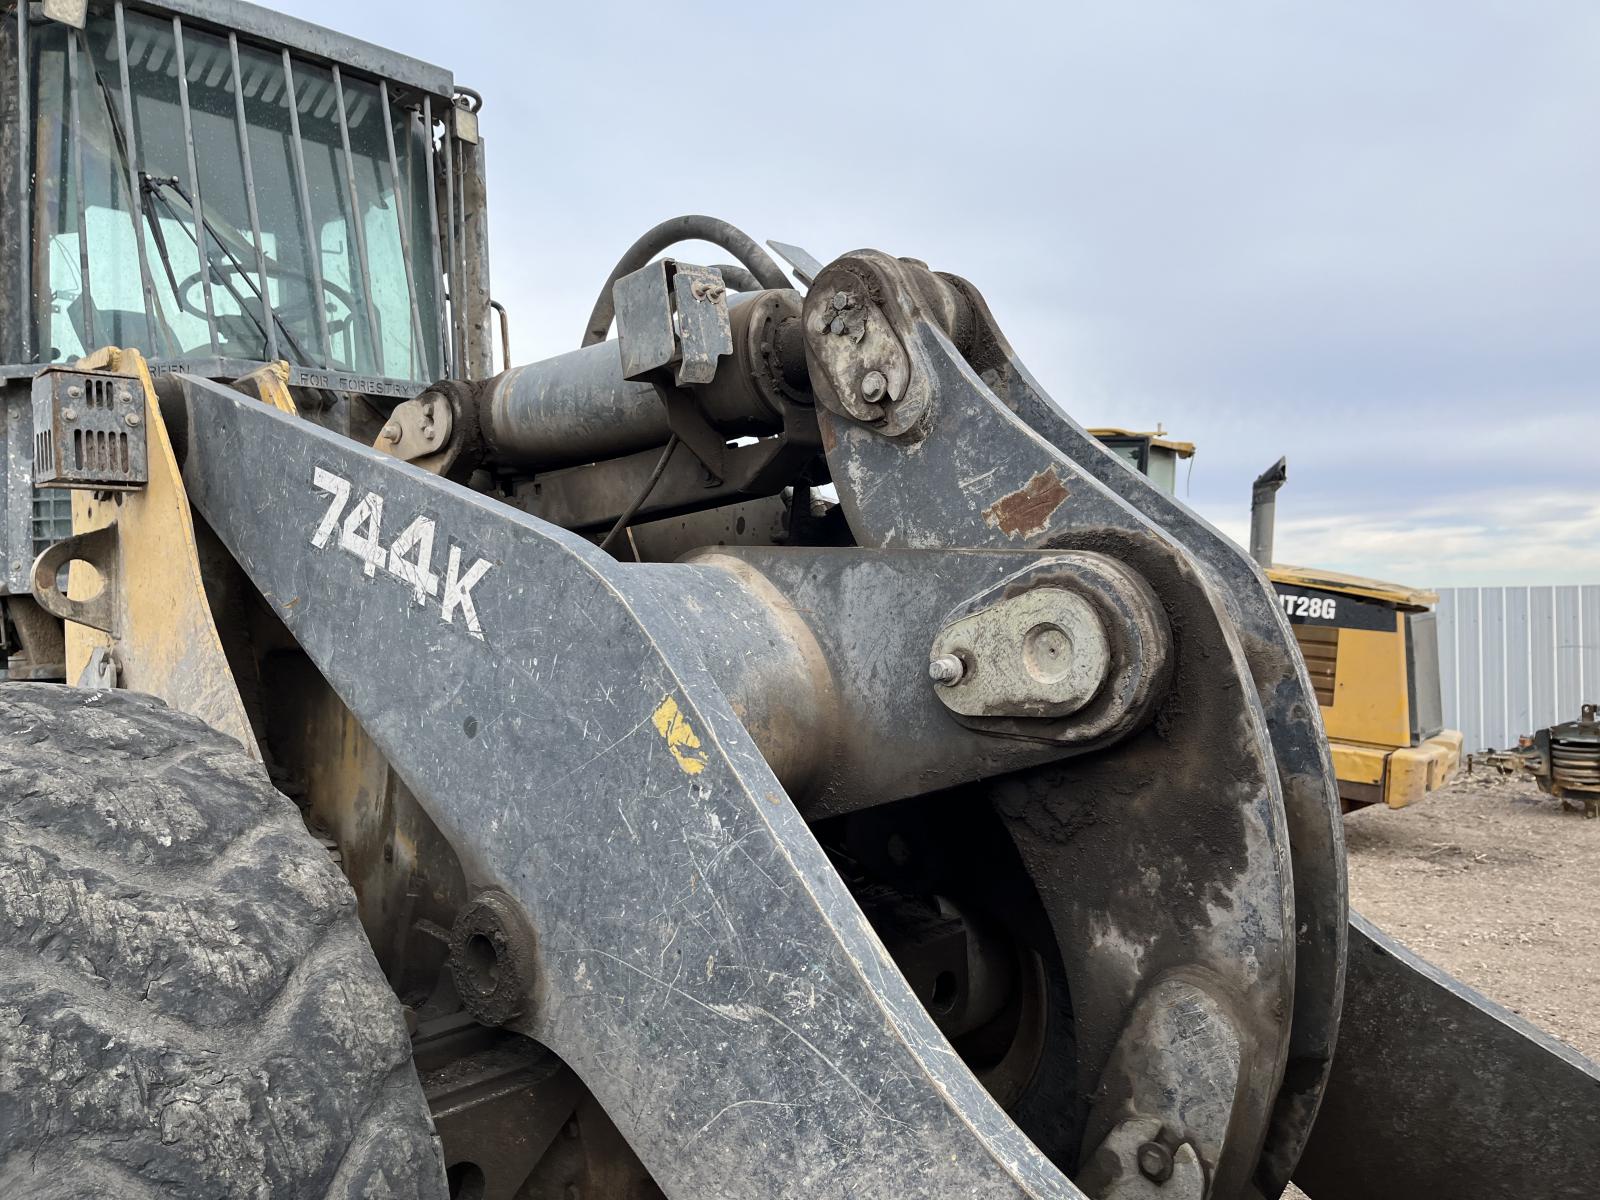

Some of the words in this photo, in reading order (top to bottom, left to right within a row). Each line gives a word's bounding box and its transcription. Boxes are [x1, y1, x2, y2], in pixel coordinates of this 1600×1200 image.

[300, 373, 329, 387] FOR
[340, 378, 409, 396] FORESTRY
[311, 466, 493, 642] 744K
